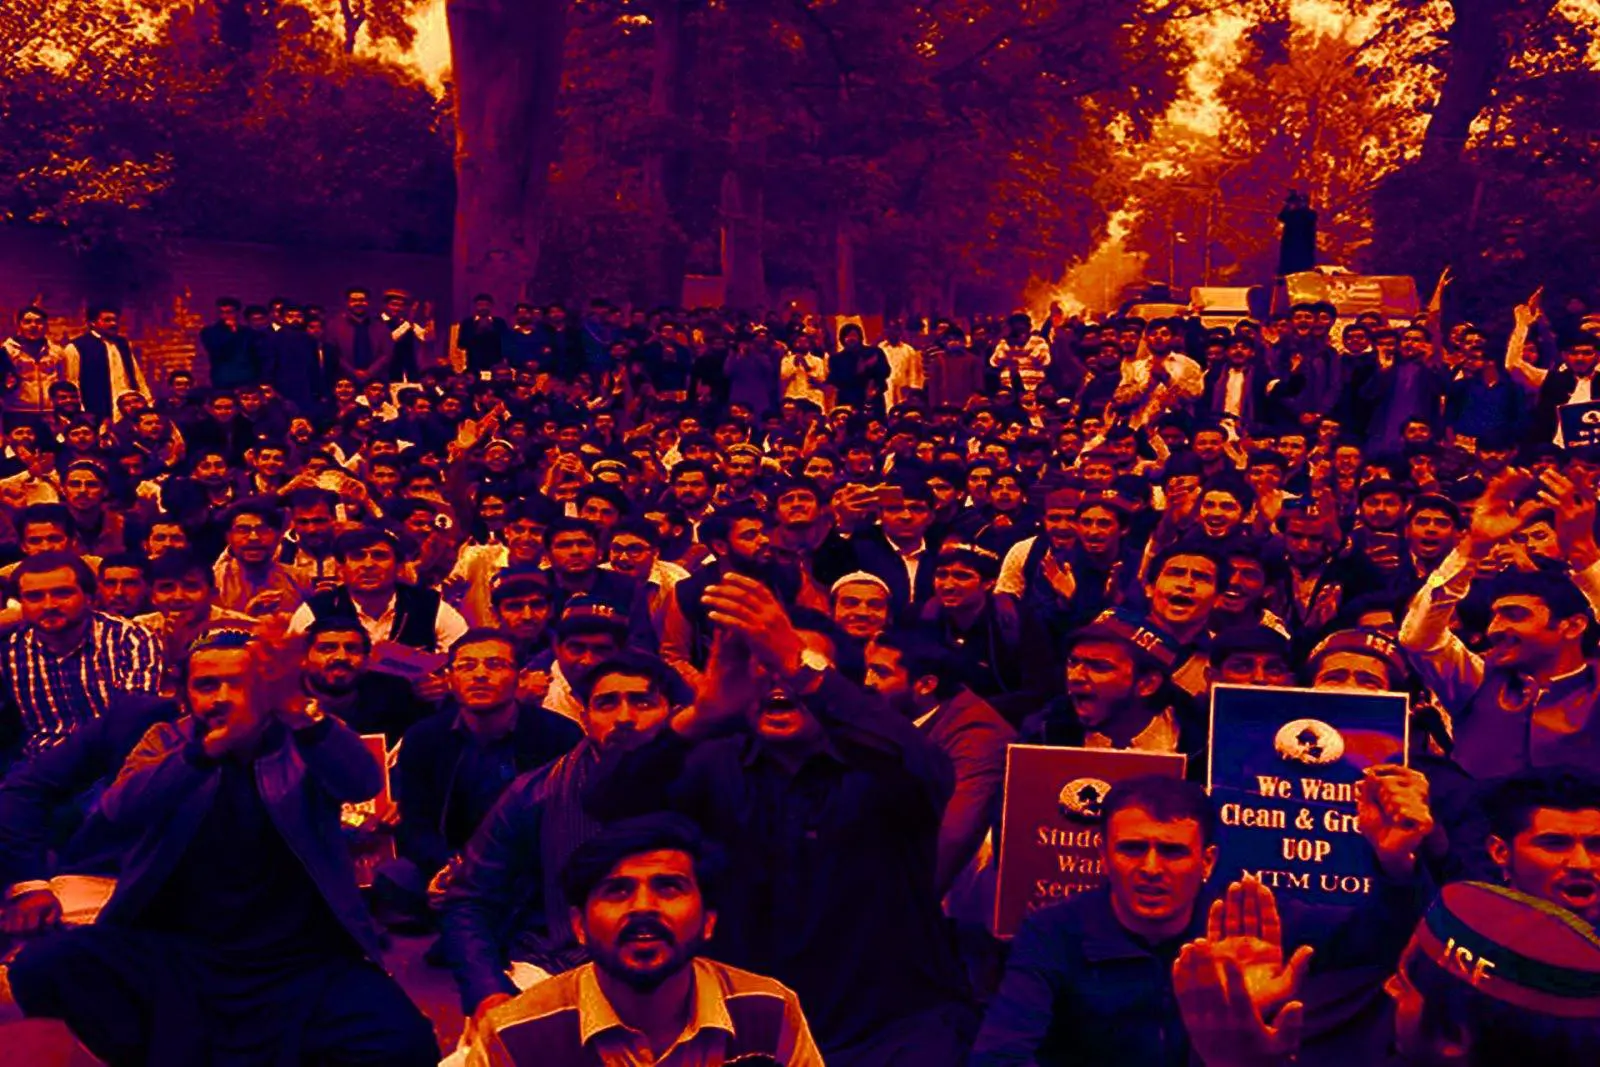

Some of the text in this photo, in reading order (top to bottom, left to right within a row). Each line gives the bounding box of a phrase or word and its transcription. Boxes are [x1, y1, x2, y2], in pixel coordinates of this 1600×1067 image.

[1131, 626, 1163, 652] ISF
[1256, 775, 1292, 798] We
[1220, 803, 1286, 828] Clean
[1294, 807, 1314, 830] &
[1282, 838, 1331, 862] UOP
[1439, 937, 1495, 985] ISF
